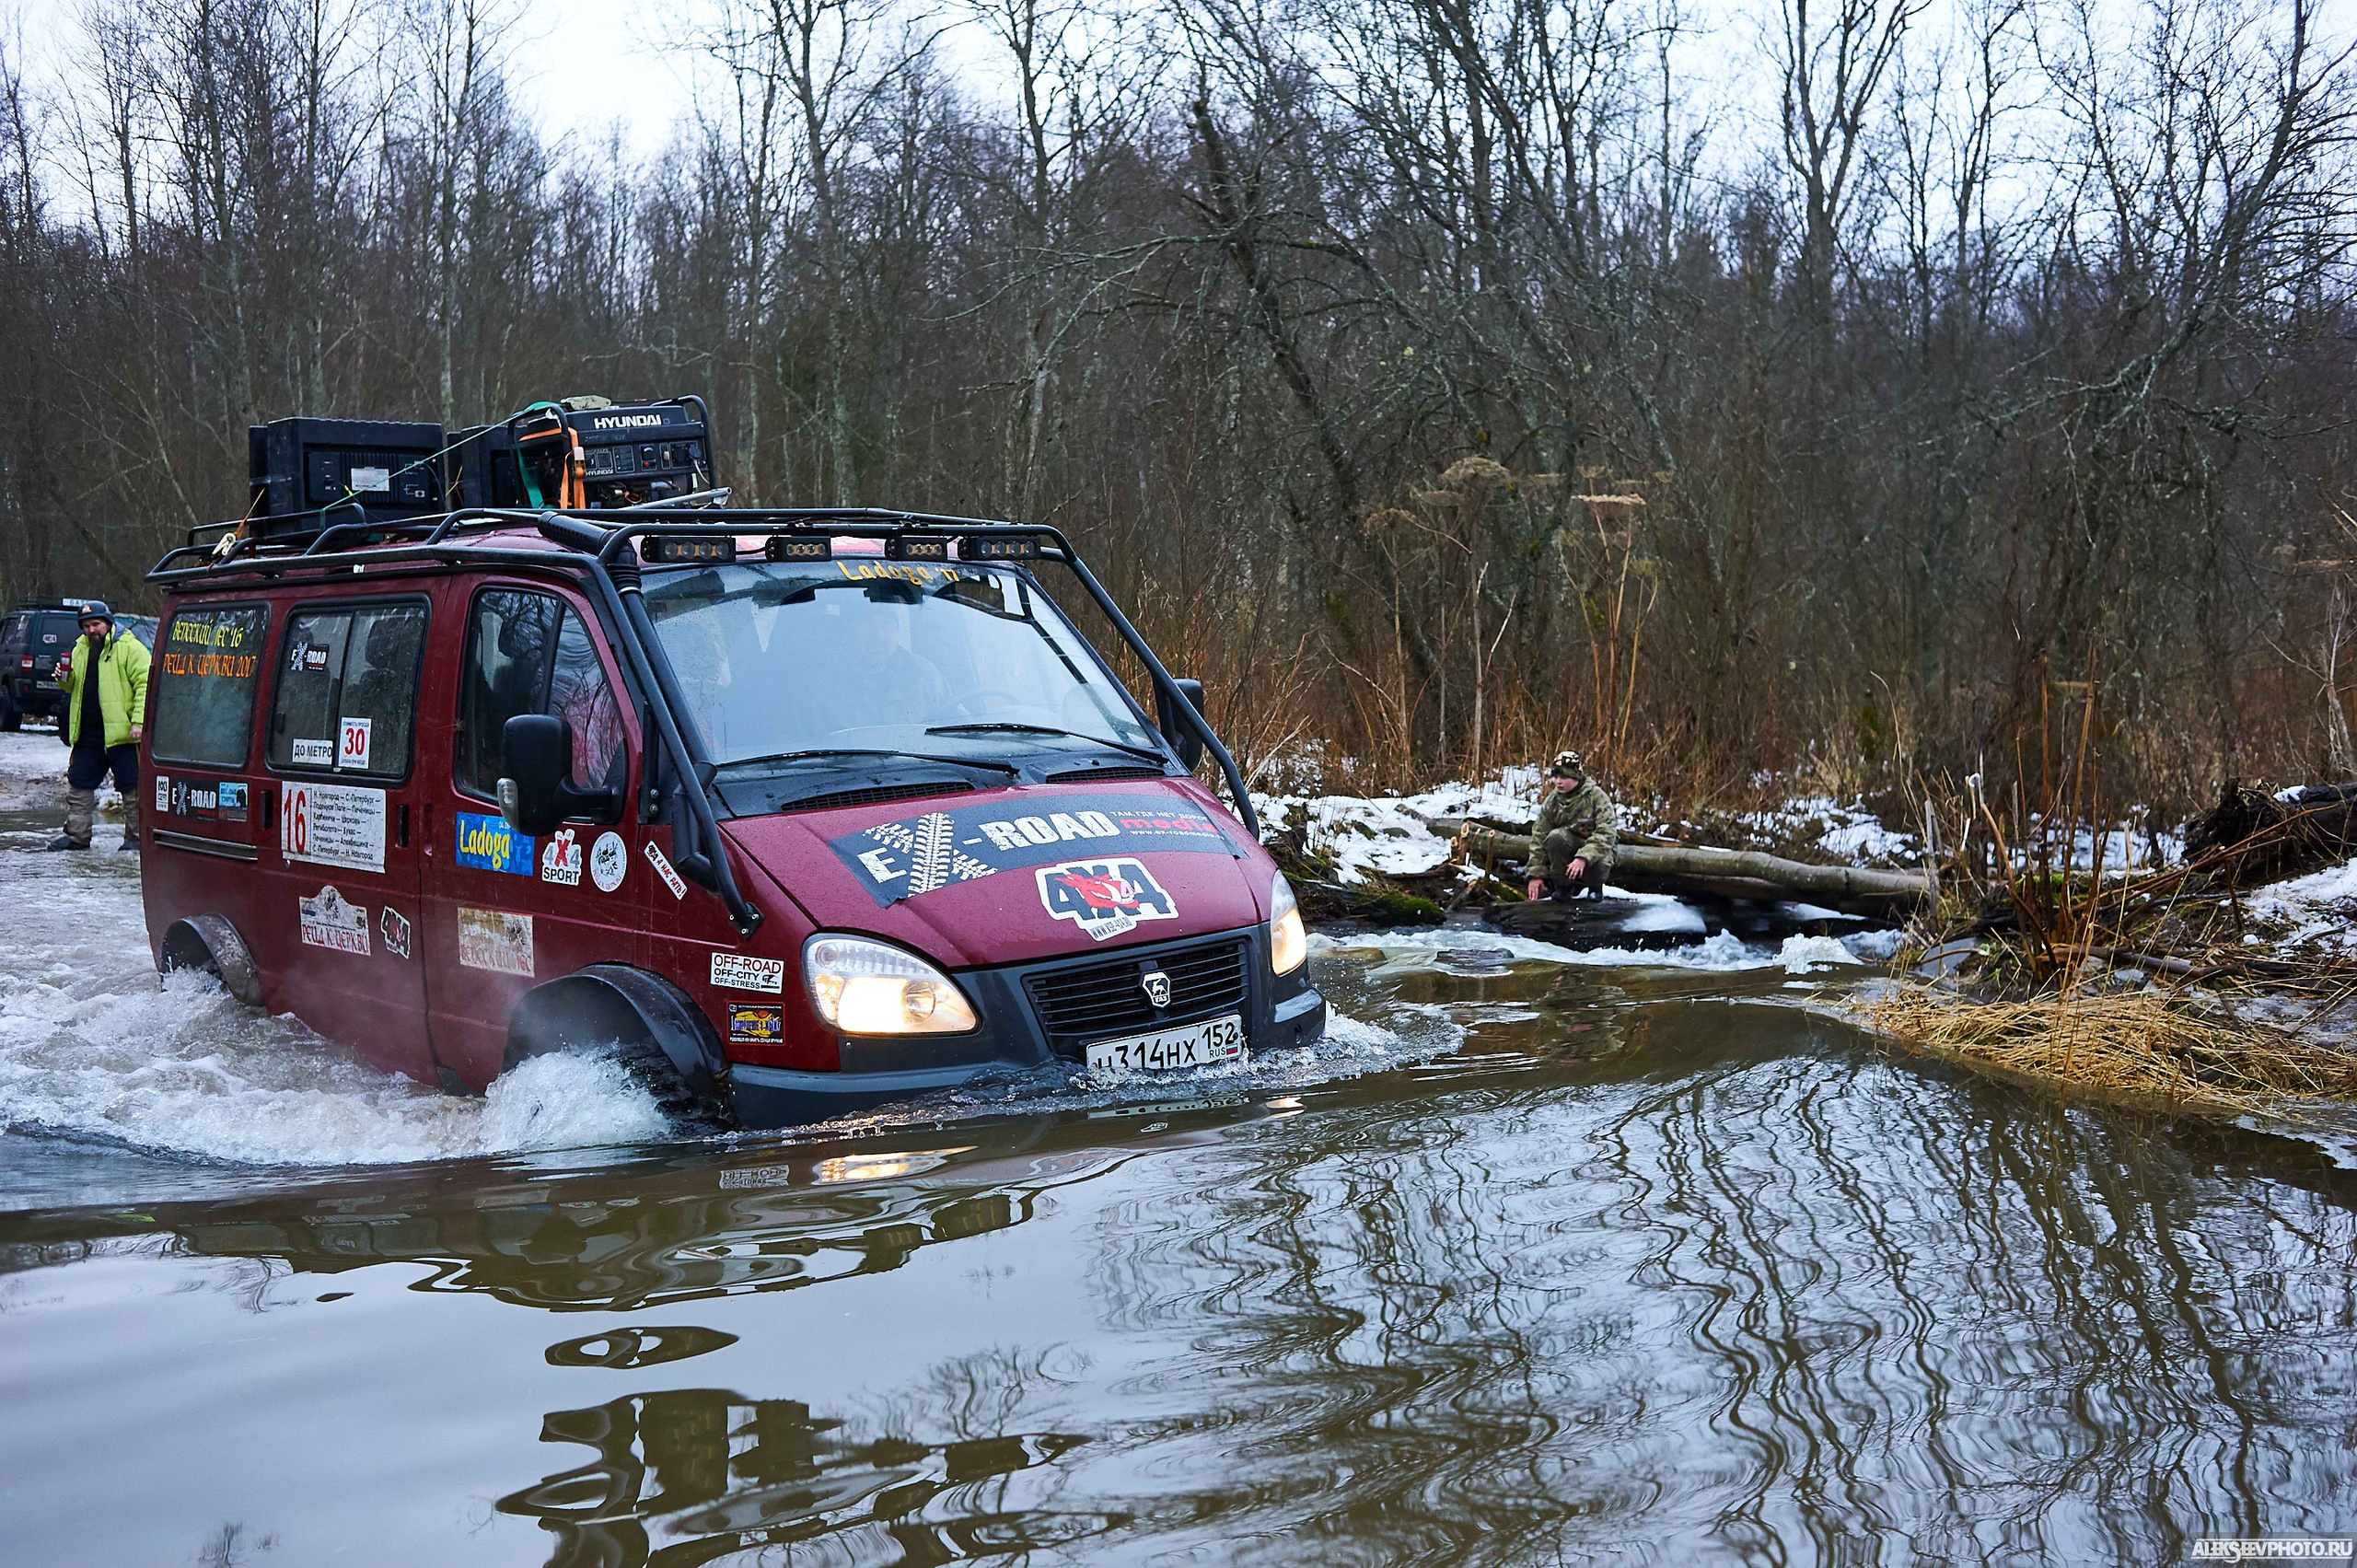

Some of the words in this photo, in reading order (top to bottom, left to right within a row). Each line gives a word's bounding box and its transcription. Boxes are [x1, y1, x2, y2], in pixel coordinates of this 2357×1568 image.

[594, 414, 662, 430] HYUNDAI
[837, 560, 934, 586] Ladoga
[188, 654, 195, 674] К
[197, 655, 236, 678] ЦЕРКВИ
[236, 655, 257, 678] 2017
[344, 727, 366, 755] 30
[295, 745, 306, 758] ДО
[307, 746, 332, 758] МЕТРО
[284, 789, 307, 854] 16
[1120, 819, 1219, 833] media
[460, 819, 511, 869] Ladoga
[543, 867, 579, 884] SPORT
[714, 955, 782, 974] OFF-ROAD
[714, 968, 760, 981] OFF-CITY
[714, 977, 761, 989] OFF-STRESS
[1155, 995, 1167, 1004] ГАЗ
[1202, 1022, 1236, 1050] 152
[1209, 1047, 1225, 1058] RUS
